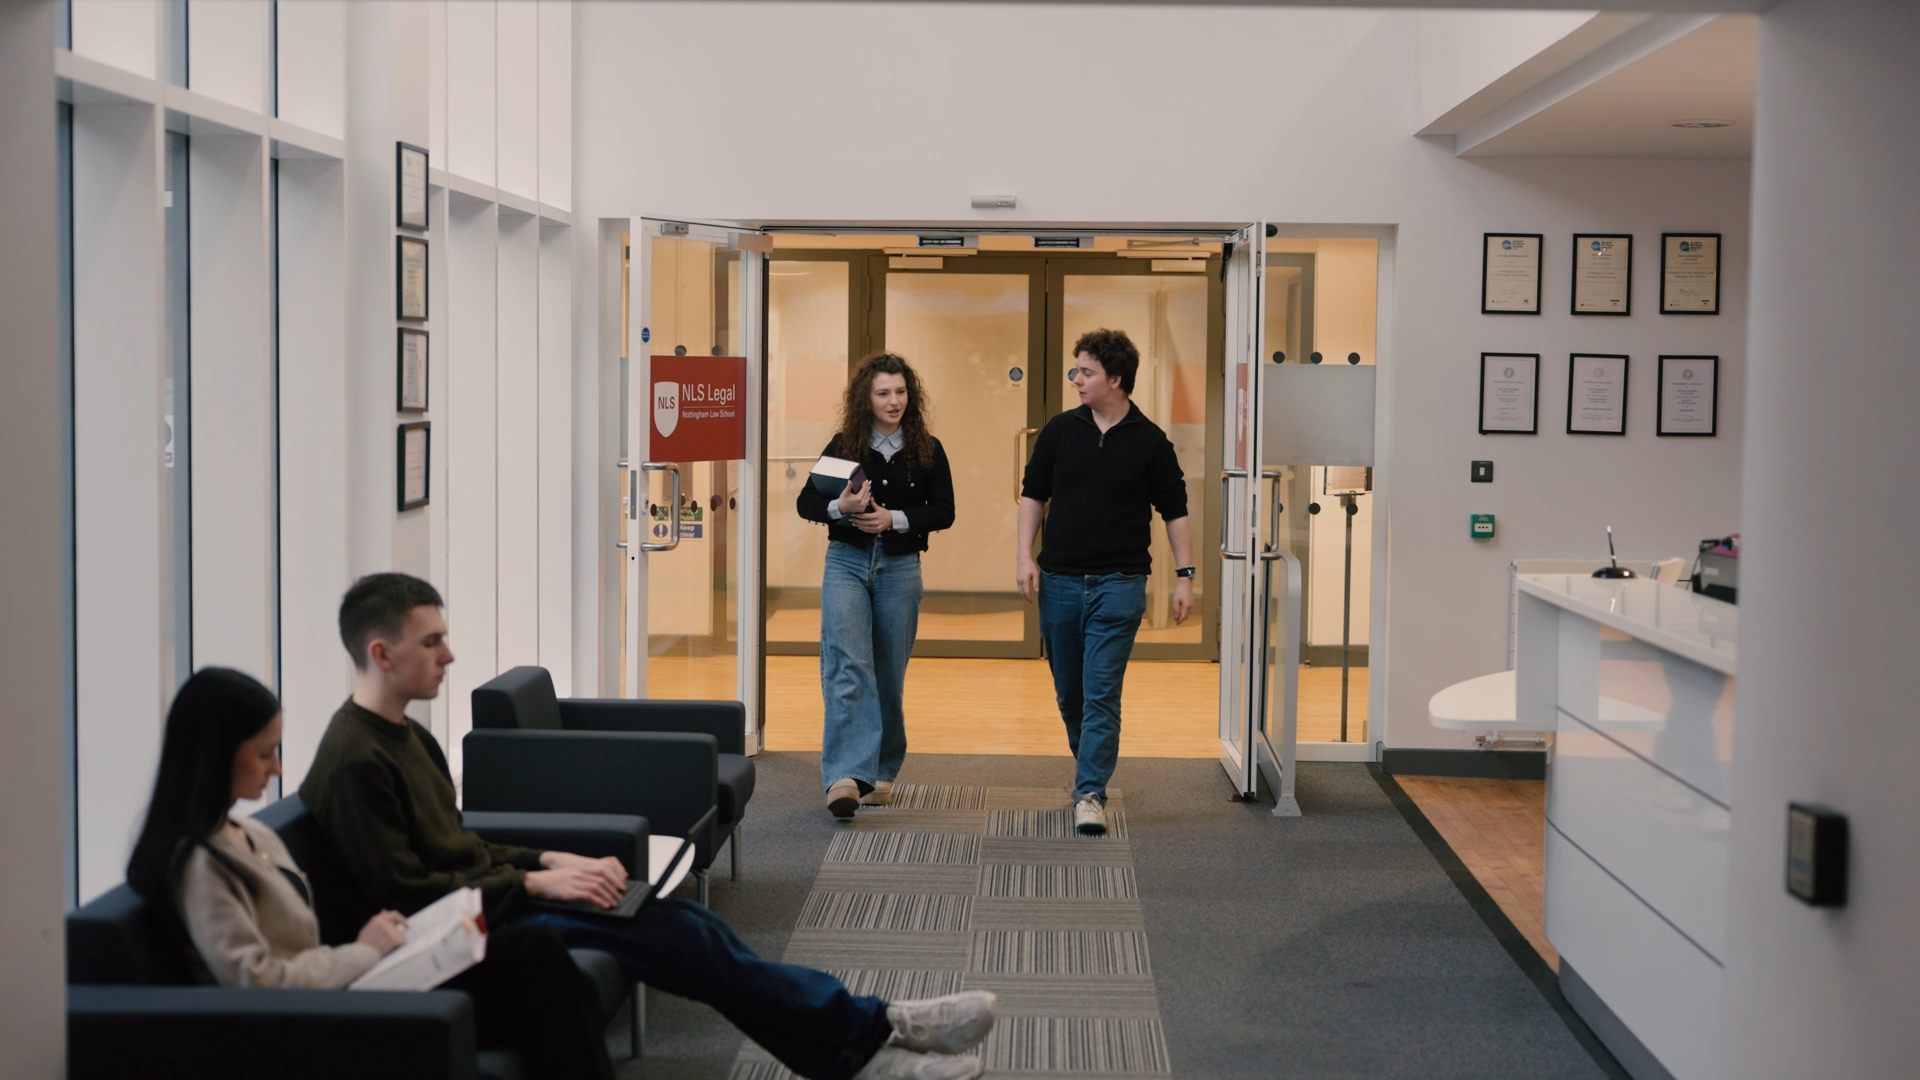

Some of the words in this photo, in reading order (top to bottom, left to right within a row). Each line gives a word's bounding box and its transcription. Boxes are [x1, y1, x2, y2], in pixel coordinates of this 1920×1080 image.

[682, 383, 705, 401] NLS
[708, 383, 736, 405] Legal
[658, 396, 675, 410] NLS
[682, 411, 709, 420] Nottingham
[710, 410, 719, 418] Law
[720, 410, 735, 418] School
[680, 524, 695, 532] Keep
